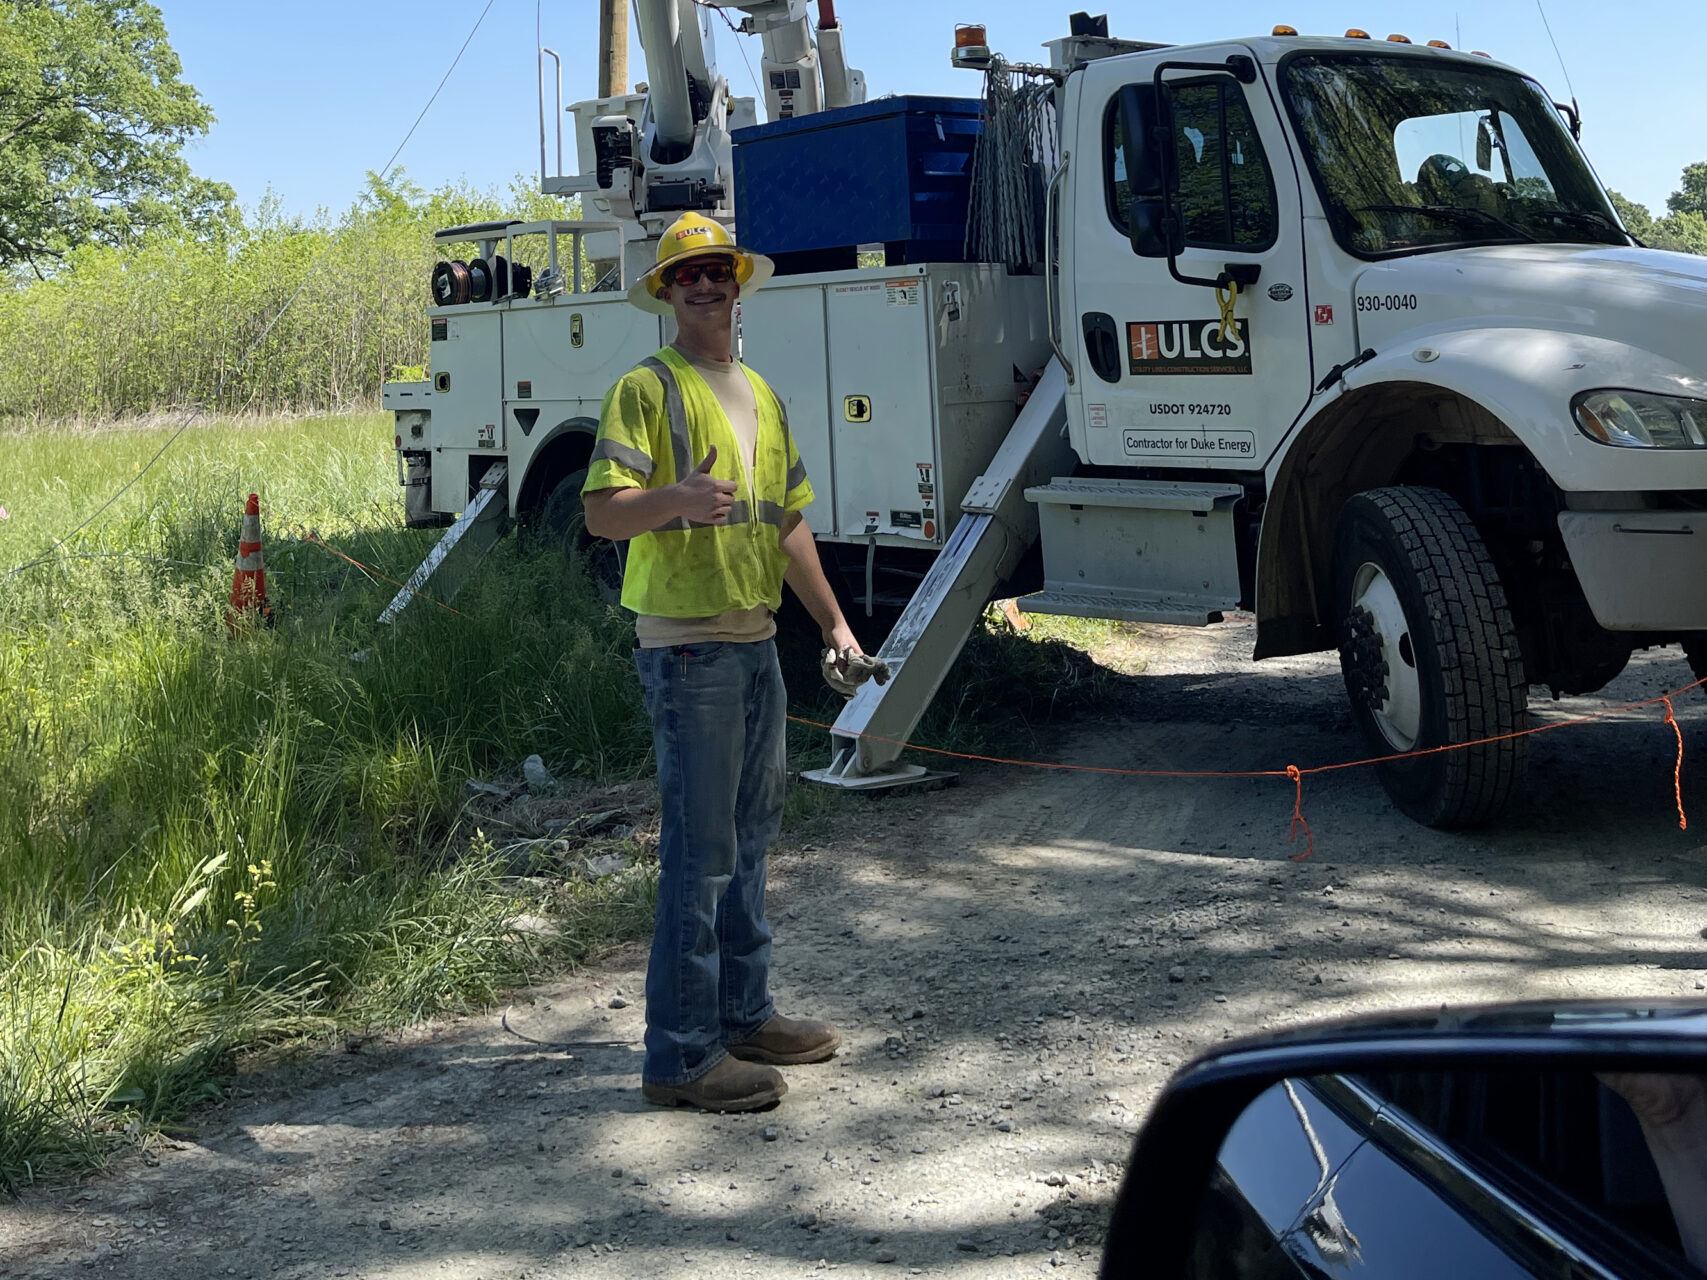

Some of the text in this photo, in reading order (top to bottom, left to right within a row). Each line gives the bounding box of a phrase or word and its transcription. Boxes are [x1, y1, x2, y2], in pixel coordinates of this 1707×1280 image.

[1357, 294, 1417, 312] 930-0040
[1157, 321, 1245, 359] ULCS
[1149, 403, 1231, 416] USDOT 924720
[1126, 437, 1251, 453] Contractor for Duke Energy
